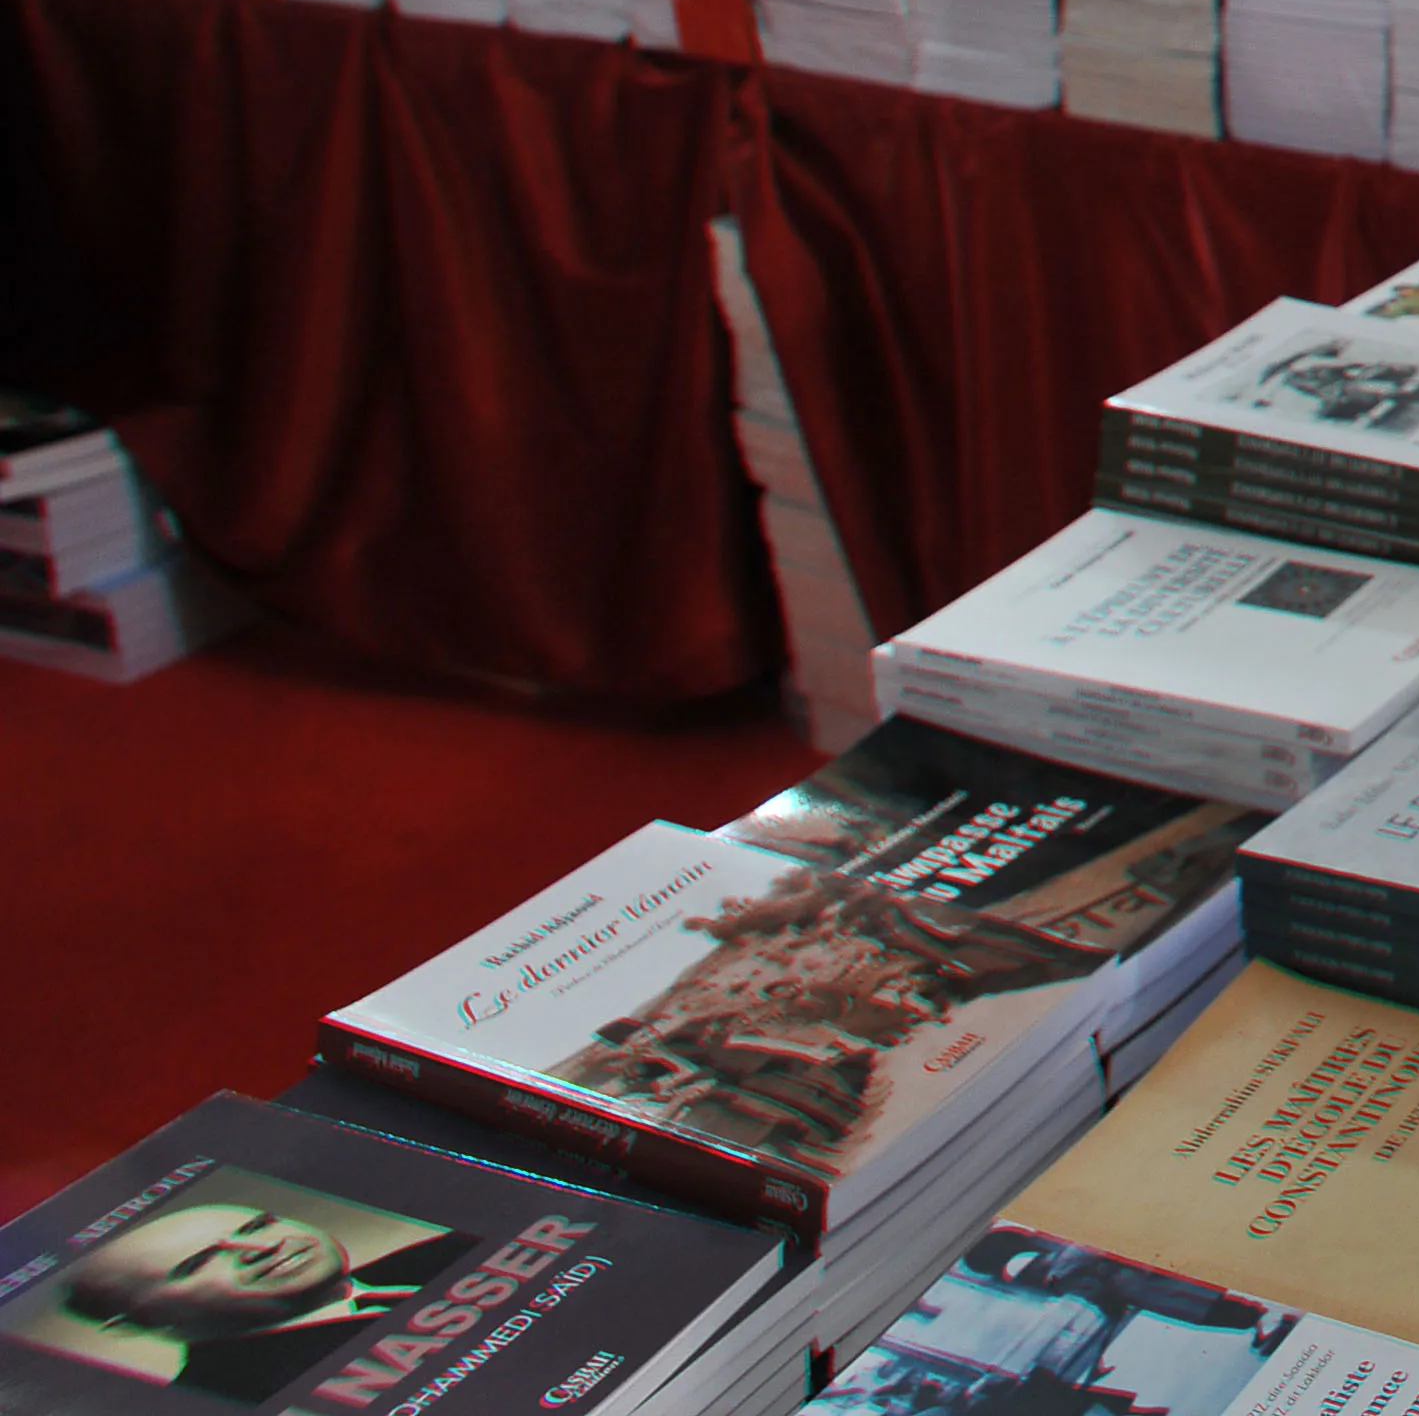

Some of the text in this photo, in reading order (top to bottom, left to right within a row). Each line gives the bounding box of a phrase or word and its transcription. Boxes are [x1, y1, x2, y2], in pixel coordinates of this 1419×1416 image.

[937, 796, 1088, 887] Maltais
[457, 988, 512, 1032] Le
[517, 919, 620, 993] dernier
[620, 861, 713, 923] témoin
[1212, 1134, 1277, 1187] LES
[1261, 1026, 1377, 1131] MAÎTRES
[1256, 1074, 1376, 1184] D'ÉCOLE
[1360, 1036, 1408, 1072] DU
[1372, 1134, 1407, 1163] DE
[312, 1214, 599, 1409] NASSER
[1283, 1343, 1319, 1381] Saadia
[540, 1349, 616, 1409] CASBAH
